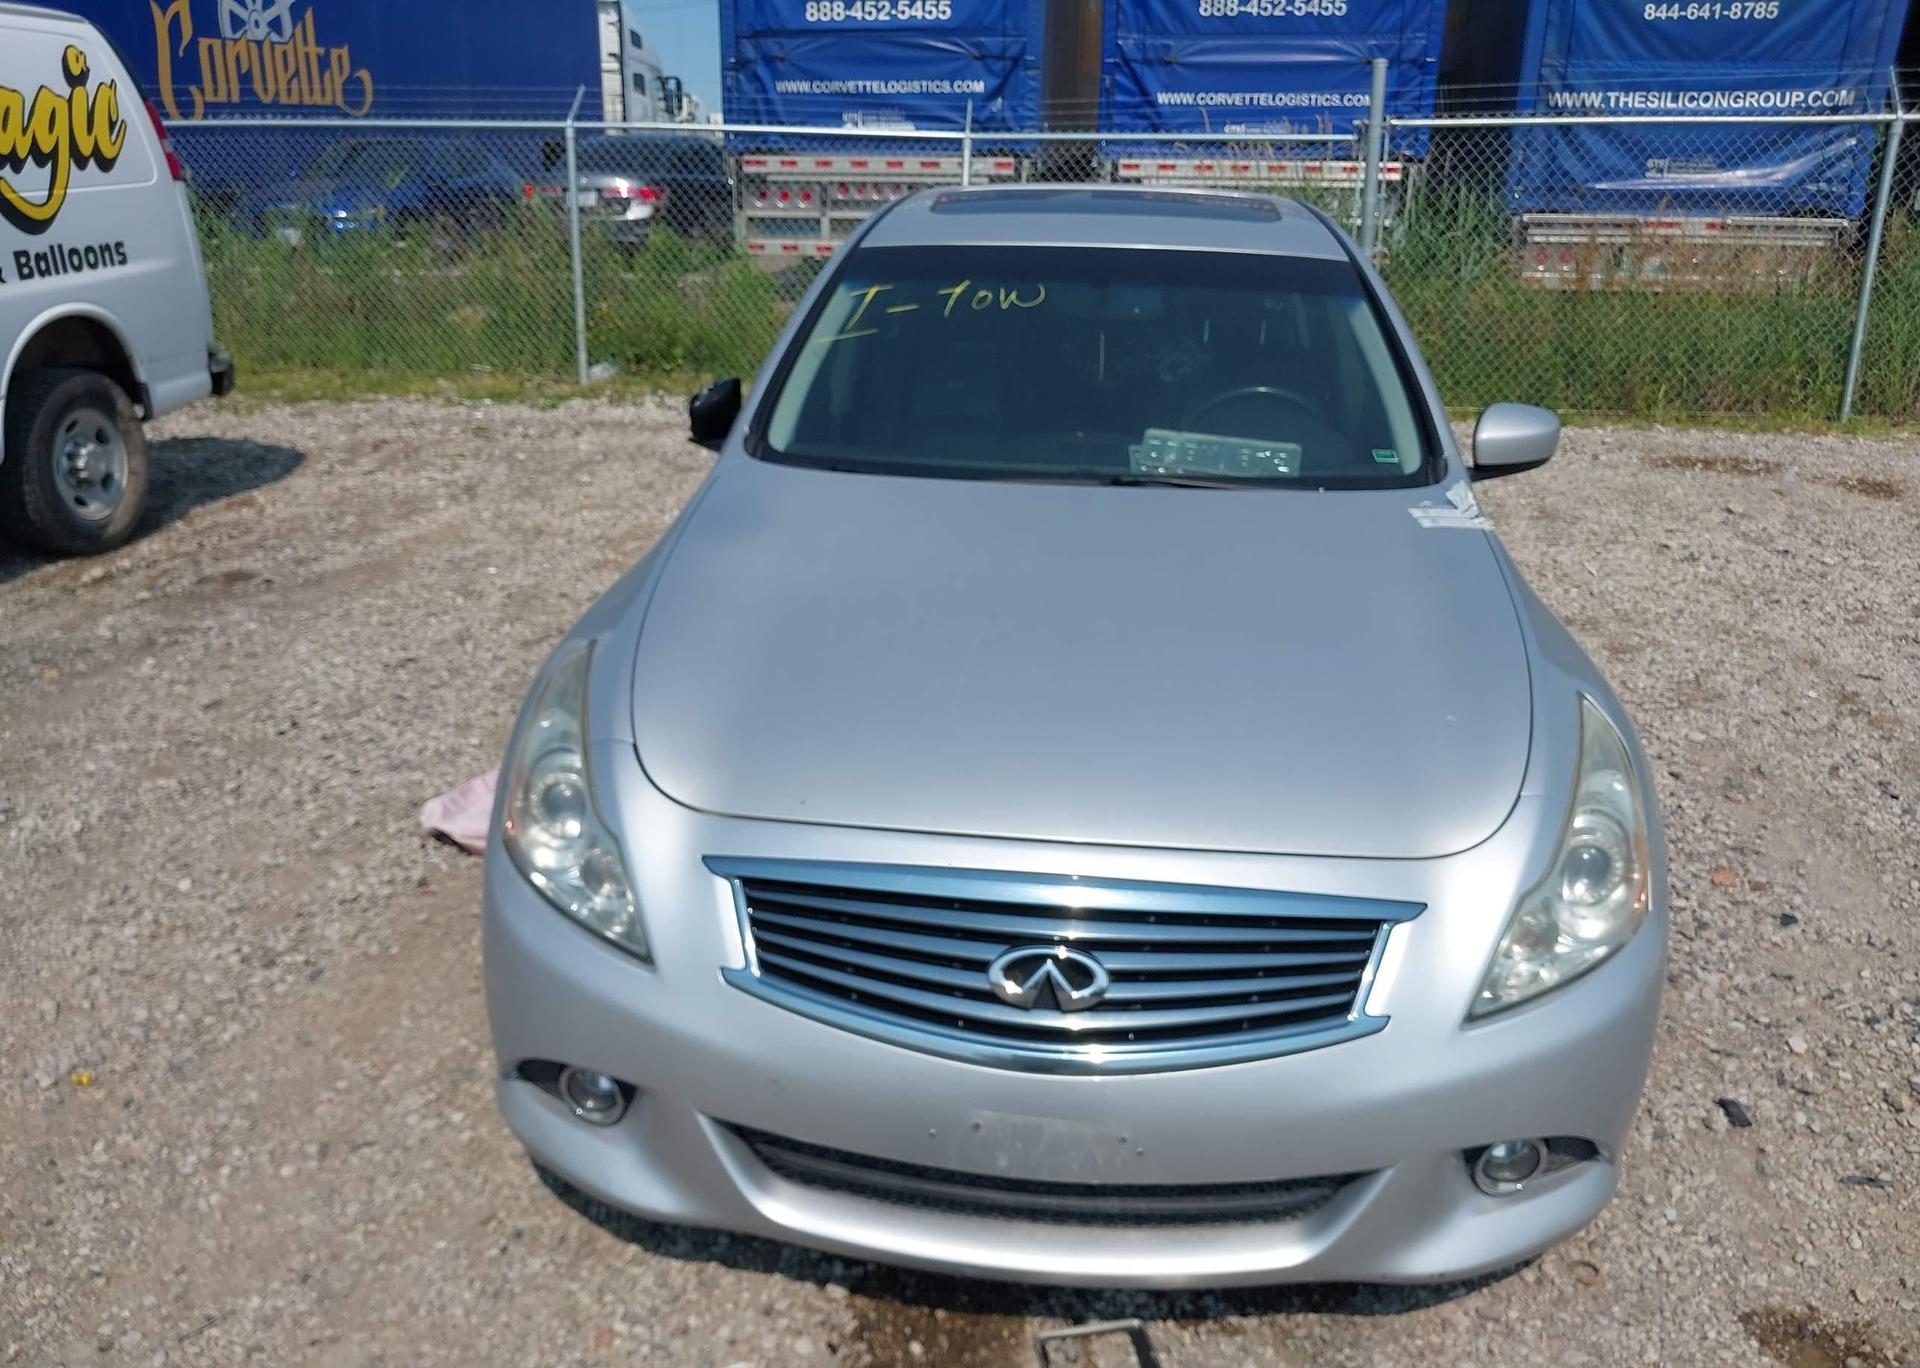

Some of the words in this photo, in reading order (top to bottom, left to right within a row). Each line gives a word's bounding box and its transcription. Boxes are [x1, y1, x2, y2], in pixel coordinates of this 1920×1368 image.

[805, 0, 952, 22] 888-452-5455
[1198, 0, 1348, 17] 888-452-5455
[1643, 2, 1779, 20] 844-641-8785
[151, 0, 374, 121] Corvette
[775, 80, 985, 94] WWW.CORVETTELOGISTICS.COM
[1548, 90, 1856, 109] WWW.THESILICONGROUP.COM
[13, 240, 128, 281] Balloons
